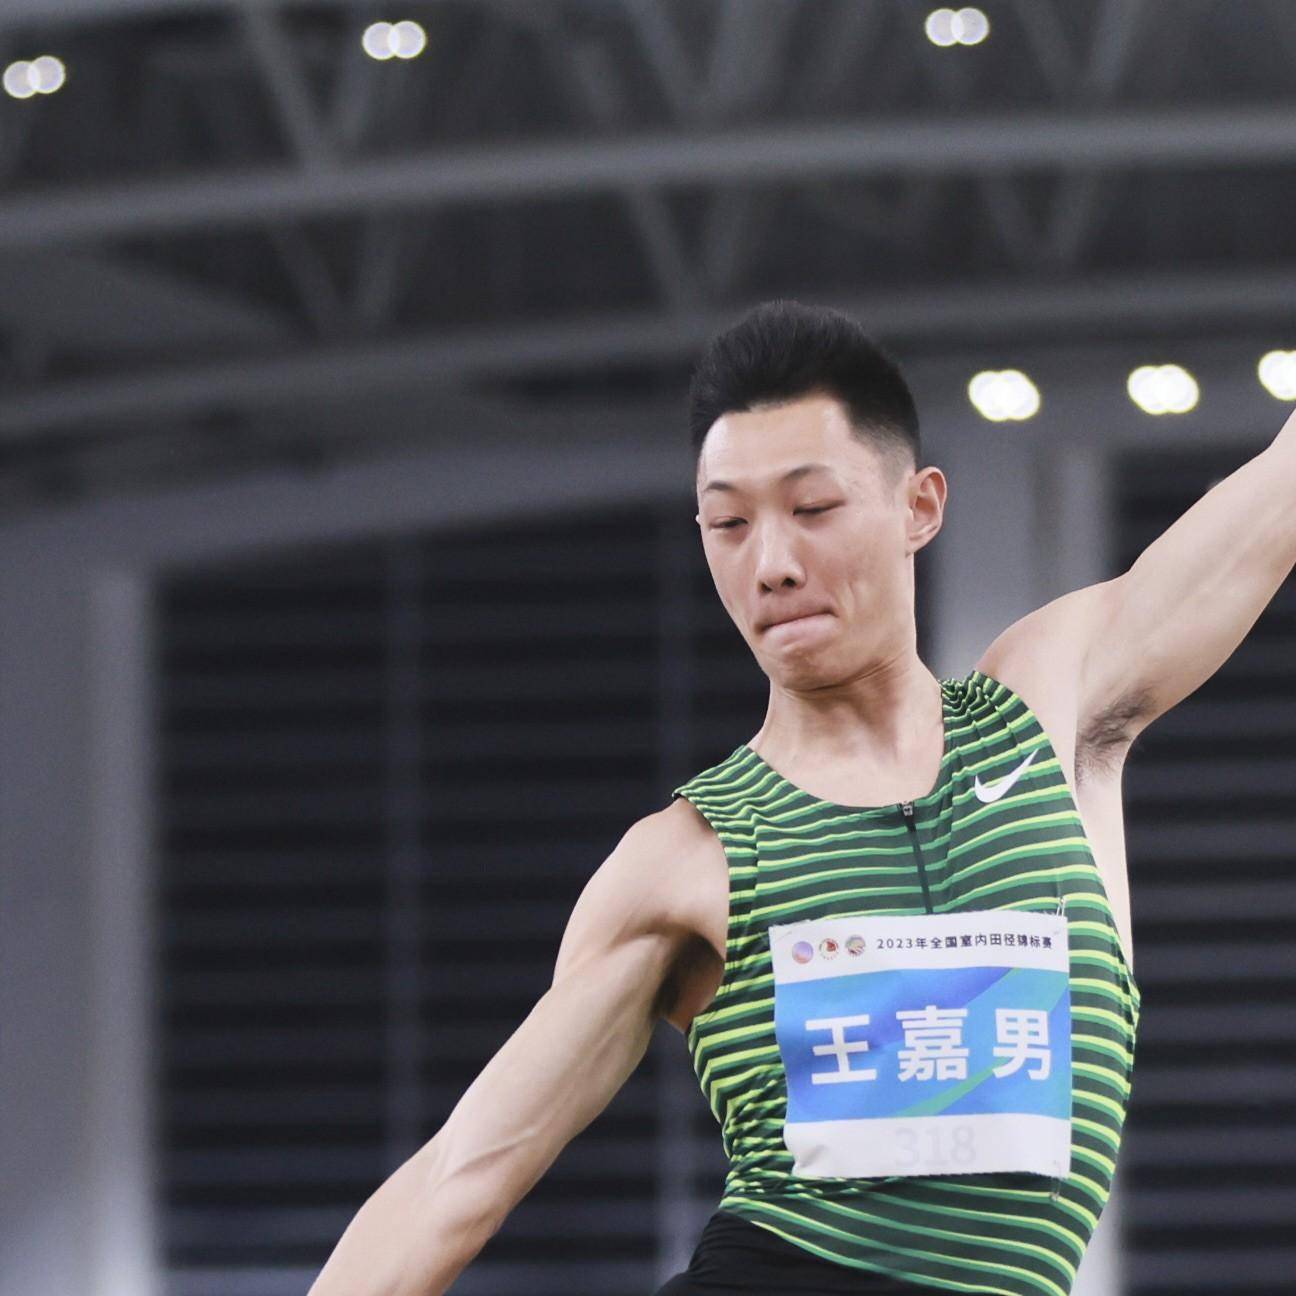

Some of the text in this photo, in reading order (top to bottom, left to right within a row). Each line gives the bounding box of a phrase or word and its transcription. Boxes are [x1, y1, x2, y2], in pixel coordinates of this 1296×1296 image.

[877, 933, 1052, 950] 2023年全国室内田径锦标赛
[805, 1005, 1052, 1085] 王嘉男
[894, 1125, 977, 1167] 318
